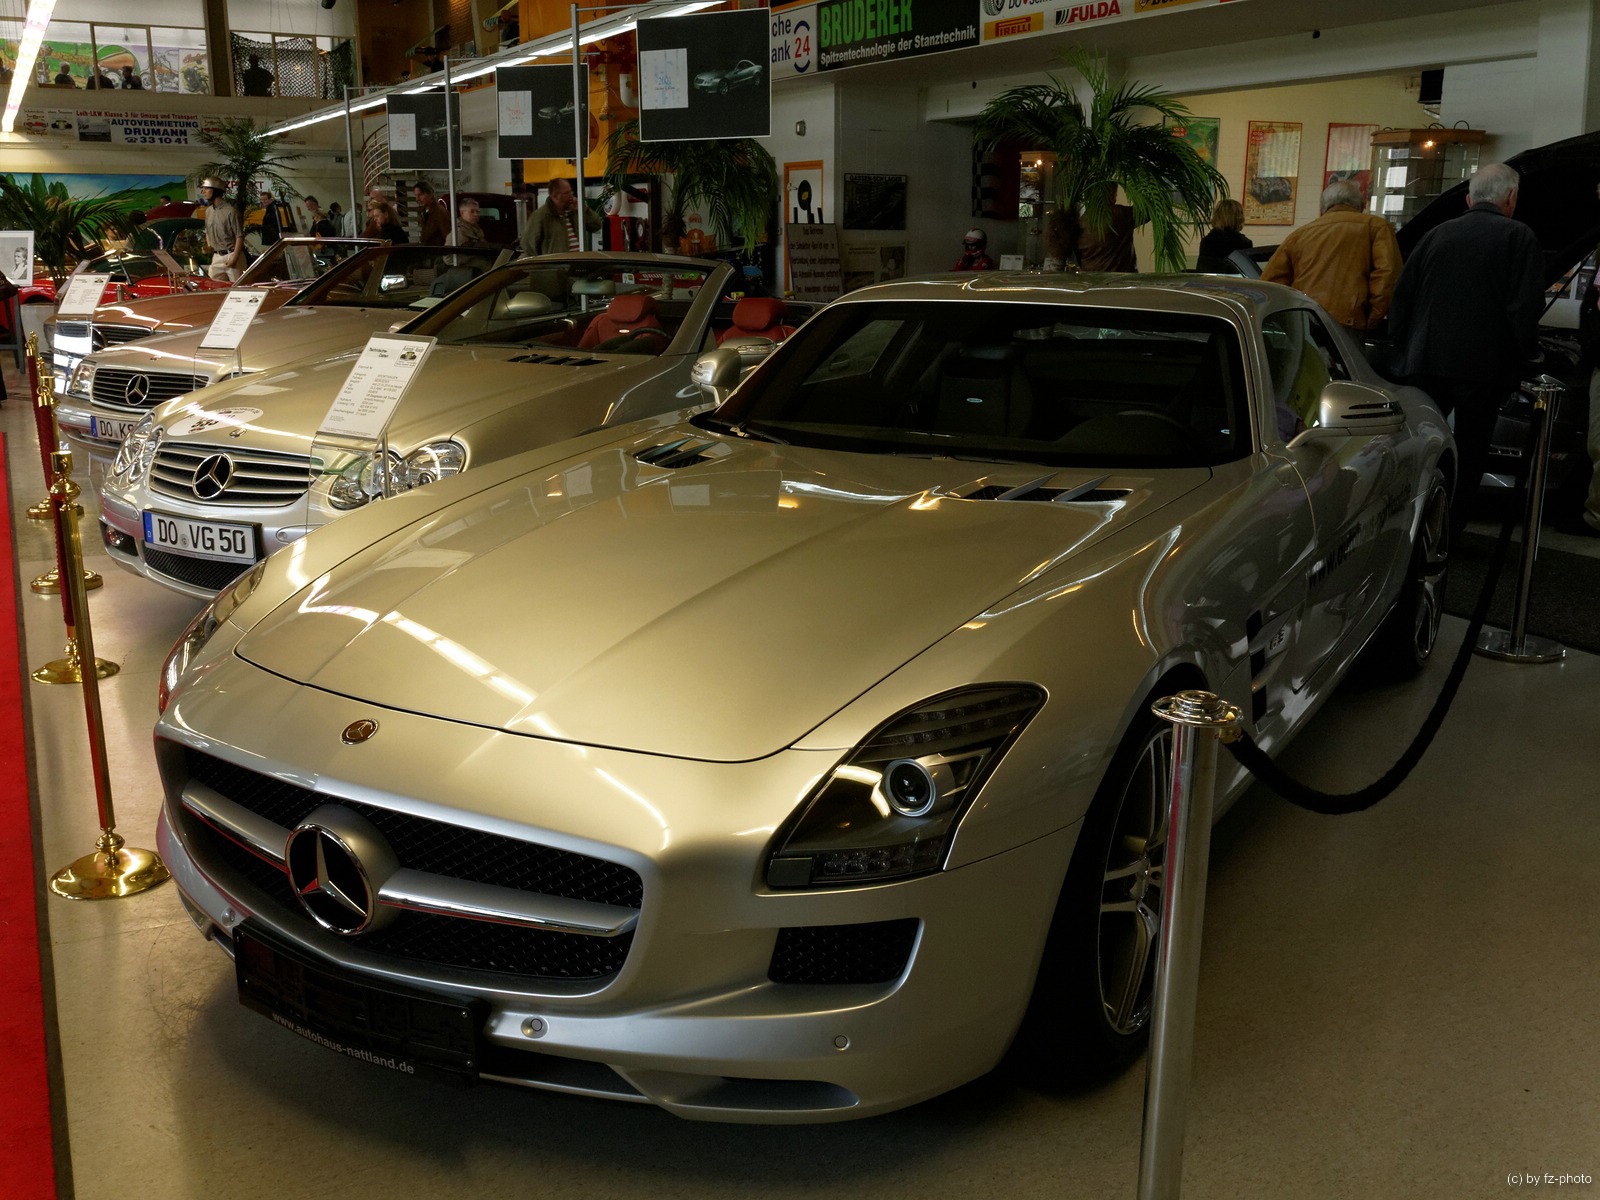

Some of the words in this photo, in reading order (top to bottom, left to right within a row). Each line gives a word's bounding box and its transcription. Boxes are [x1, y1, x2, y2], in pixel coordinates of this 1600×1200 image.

[1067, 0, 1120, 23] FULDA
[772, 15, 791, 37] che
[820, 0, 913, 48] BRUDERER
[995, 16, 1031, 37] PIRELLI
[771, 40, 790, 63] ank
[795, 35, 810, 58] 24
[820, 41, 895, 67] Spitzentechnologie
[898, 38, 912, 52] der
[914, 25, 976, 49] Stanztechnik
[111, 119, 199, 128] AUTOVERMIETUNG
[124, 127, 187, 137] DRUMANN
[174, 137, 188, 145] 41
[99, 420, 113, 437] DO
[157, 518, 178, 545] DO
[188, 524, 215, 551] VG
[218, 528, 246, 554] 50
[272, 1011, 416, 1074] www.autohaus-nattland.de
